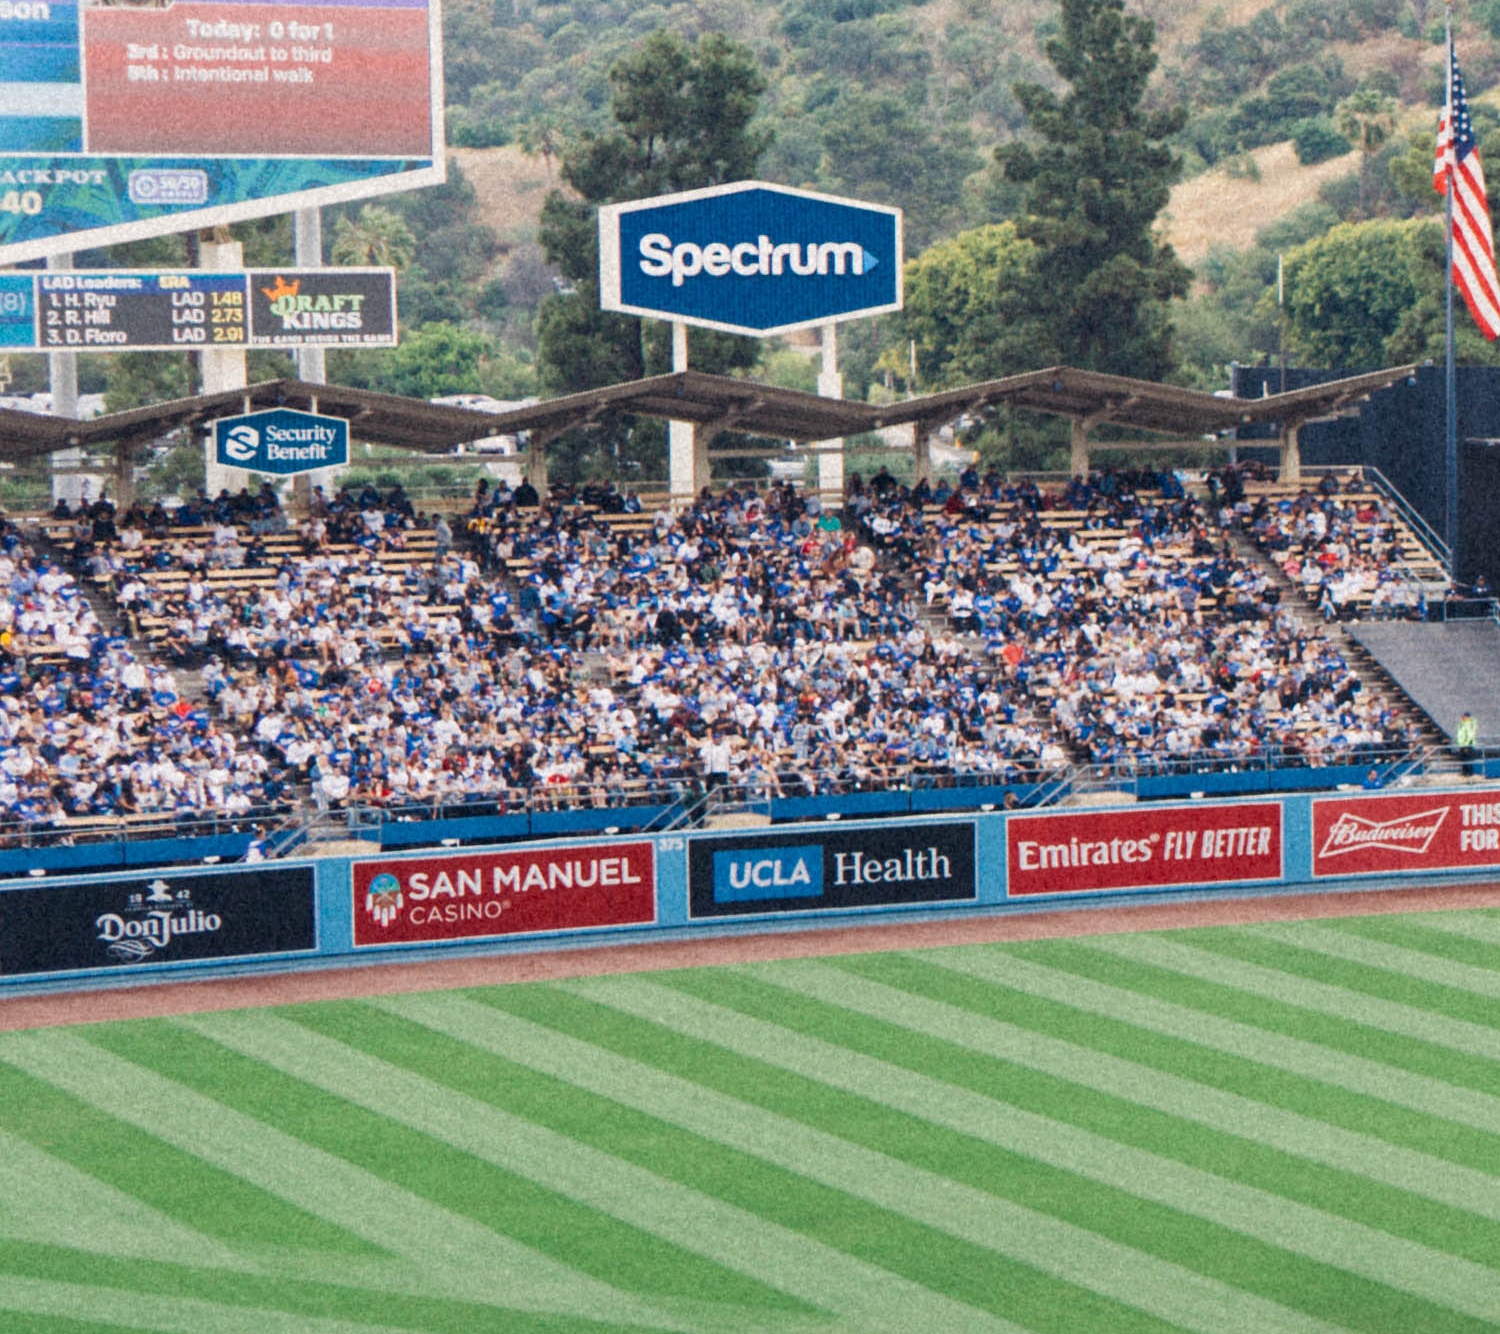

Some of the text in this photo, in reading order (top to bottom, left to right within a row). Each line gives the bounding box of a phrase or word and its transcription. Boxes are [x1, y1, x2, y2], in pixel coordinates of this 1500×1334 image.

[186, 20, 261, 42] Today:
[288, 21, 320, 41] for
[639, 233, 863, 286] Spectrum
[84, 293, 116, 312] Ryu
[172, 292, 204, 307] LAD
[270, 294, 364, 317] DRAFT
[172, 309, 205, 325] LAD
[283, 312, 363, 330] KINGS
[173, 327, 206, 343] LAD
[265, 424, 337, 449] Security
[266, 443, 326, 461] Benefit
[1330, 821, 1437, 846] Budweiser
[1460, 829, 1500, 852] FOR
[1018, 825, 1272, 871] Emirates FLY BETTER
[409, 857, 641, 900] SAN MANUEL
[729, 848, 952, 889] UCLA Health
[409, 900, 502, 926] CASINO
